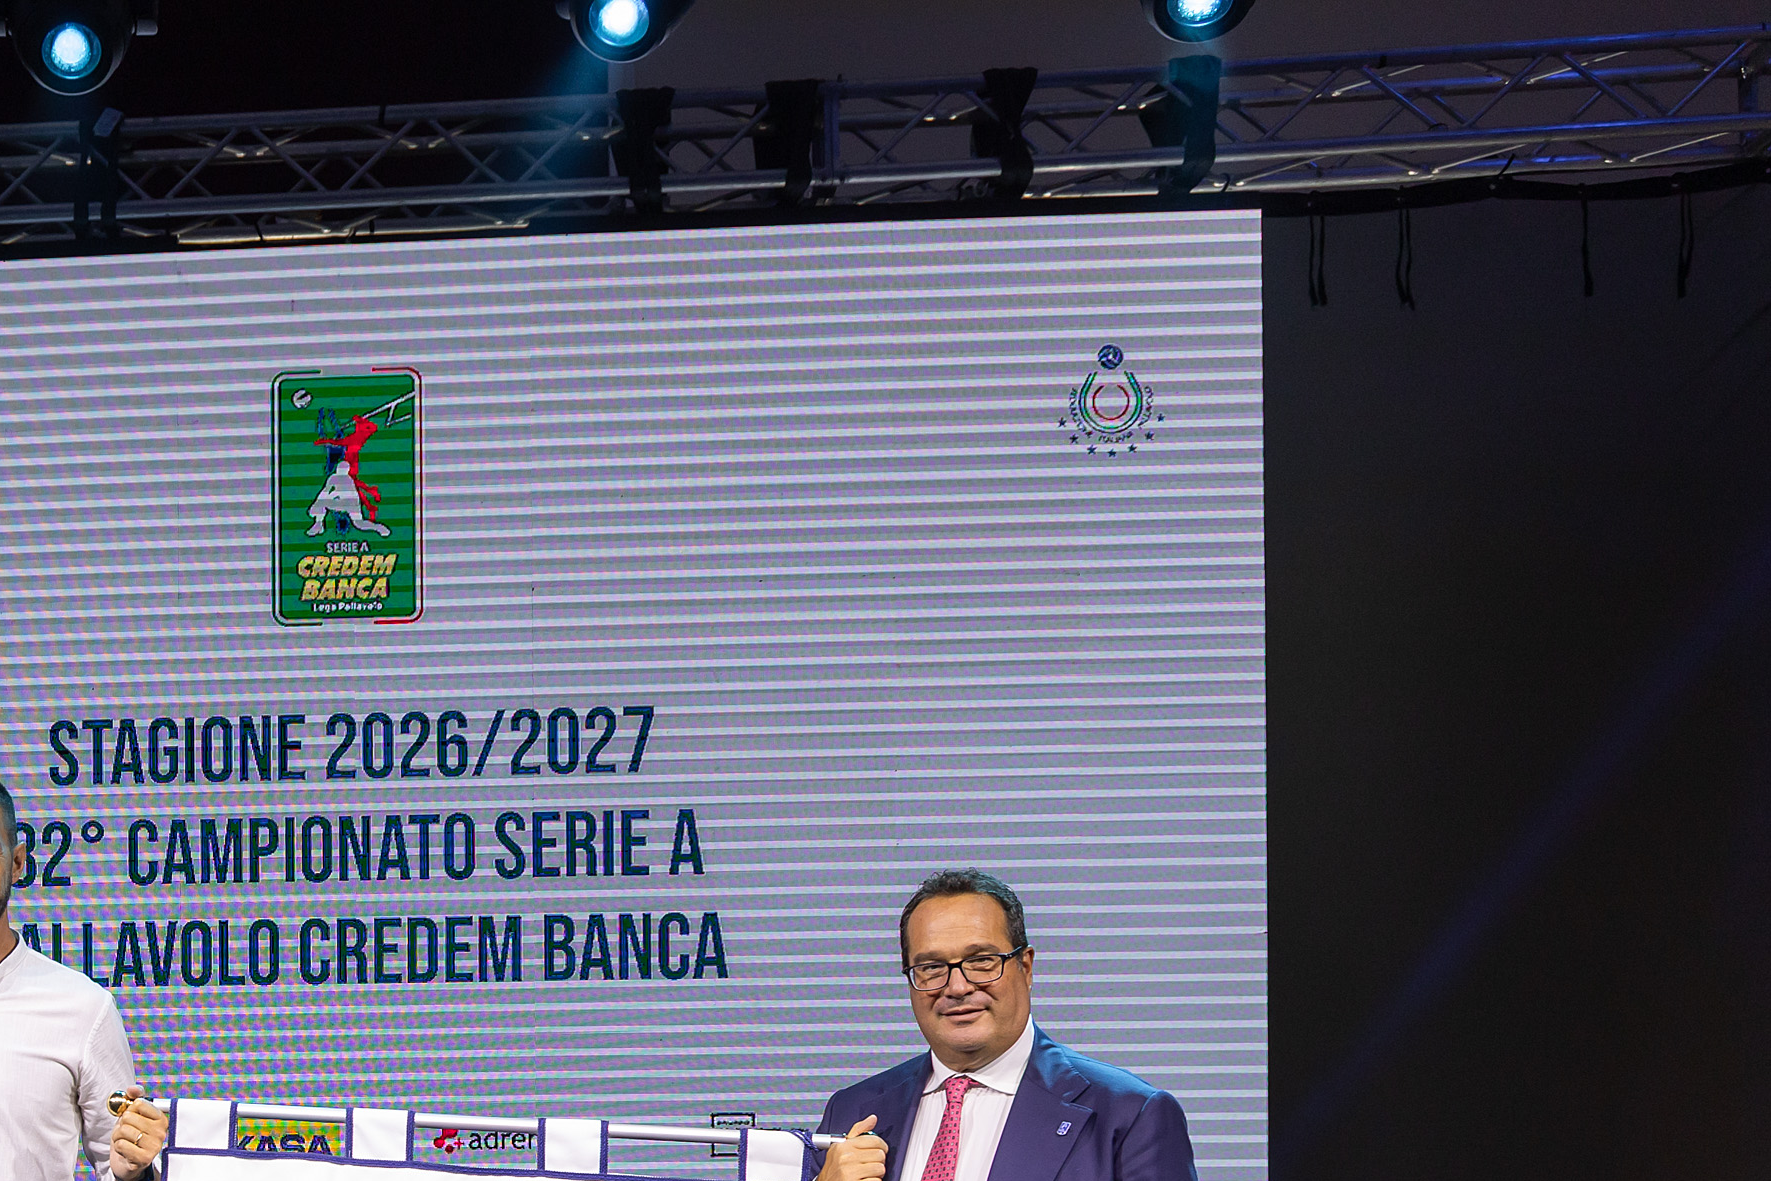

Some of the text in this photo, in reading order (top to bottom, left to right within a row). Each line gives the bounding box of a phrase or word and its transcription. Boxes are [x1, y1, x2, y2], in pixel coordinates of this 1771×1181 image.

[298, 553, 397, 578] CREDEM
[326, 541, 370, 554] SERIE A
[301, 577, 388, 601] BANCA
[49, 704, 655, 786] STAGIONE 2026/2027
[128, 810, 476, 886] CAMPIONATO
[494, 809, 650, 880] SERIE
[668, 808, 705, 876] A
[298, 914, 523, 986] CREDEM
[543, 911, 730, 982] BANCA
